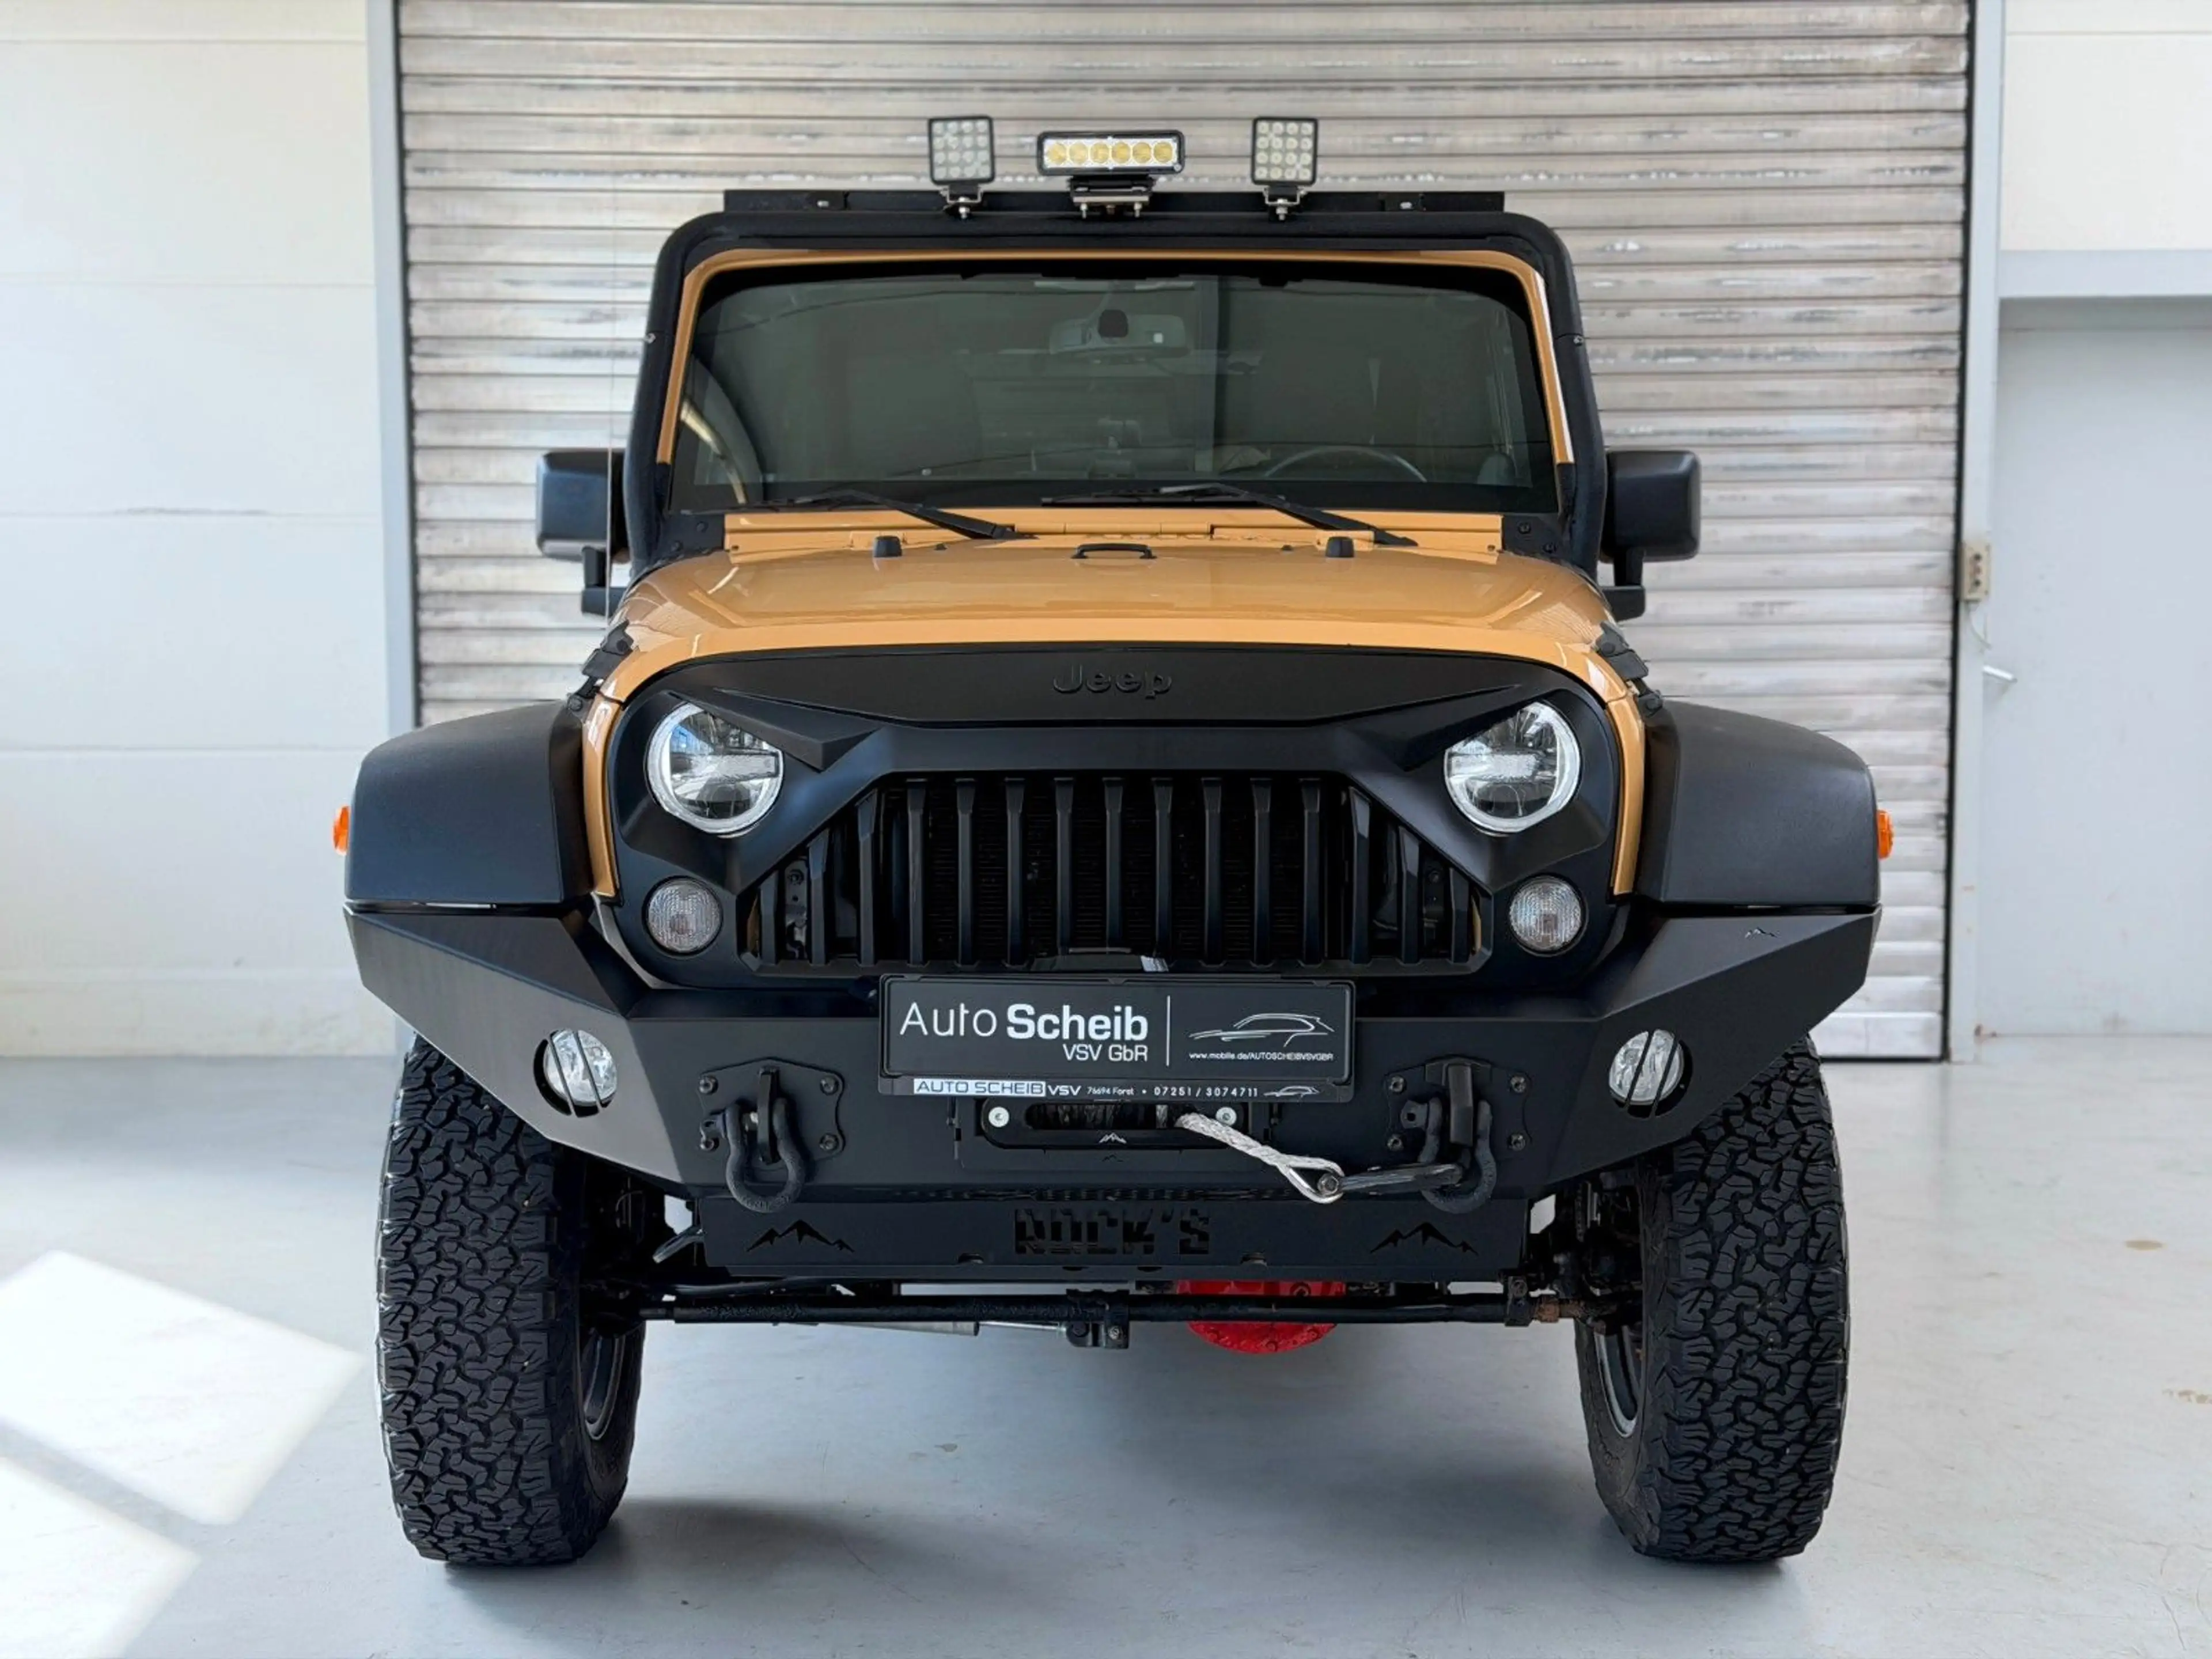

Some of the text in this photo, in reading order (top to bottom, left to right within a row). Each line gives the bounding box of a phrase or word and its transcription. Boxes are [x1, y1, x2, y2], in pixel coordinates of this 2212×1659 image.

[1053, 663, 1173, 700] Jeep
[899, 1002, 1149, 1040] Auto Scheib
[1062, 1043, 1149, 1062] VSV GbR
[916, 1081, 968, 1093] AUTO
[975, 1082, 1044, 1095] SCHEIB
[1047, 1084, 1082, 1096] VSV
[1112, 1087, 1134, 1096] Forst
[1154, 1086, 1191, 1096] 07251
[1206, 1087, 1258, 1097] 3074711
[1014, 1209, 1210, 1255] ROCK'S
